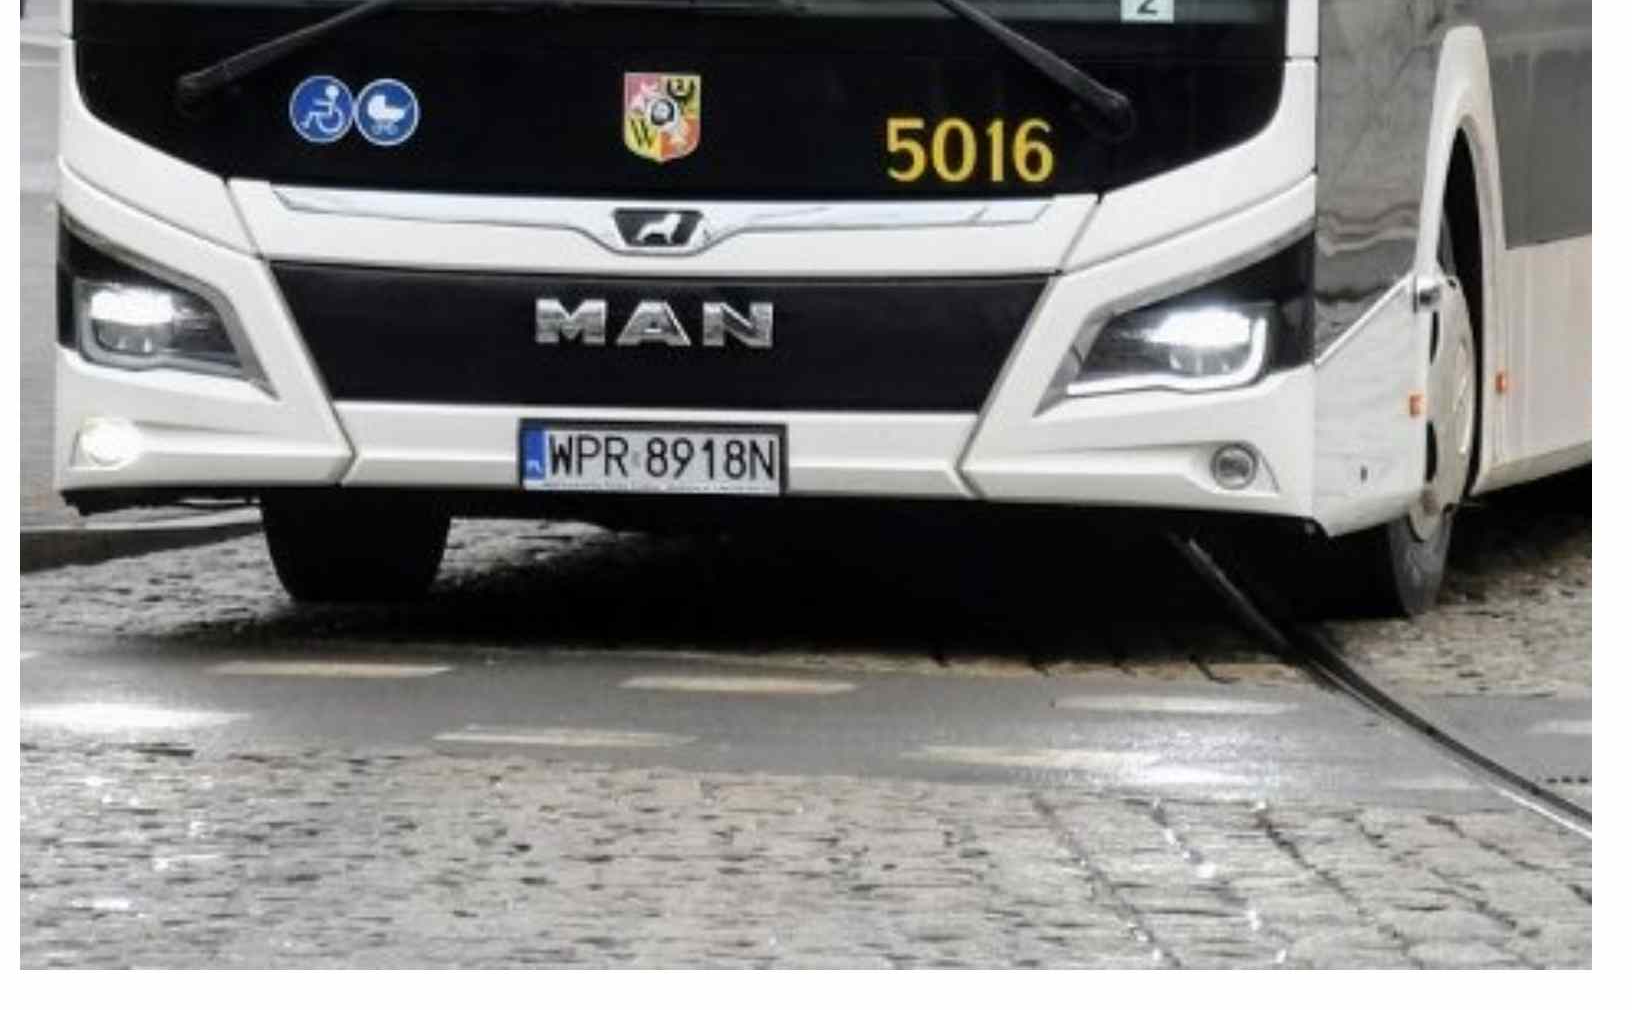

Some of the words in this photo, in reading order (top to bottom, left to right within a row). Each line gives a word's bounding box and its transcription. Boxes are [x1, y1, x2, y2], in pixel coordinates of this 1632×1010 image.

[887, 117, 1054, 183] 5016
[535, 298, 774, 349] MAN
[549, 437, 628, 477] WPR
[646, 437, 775, 481] 8918N
